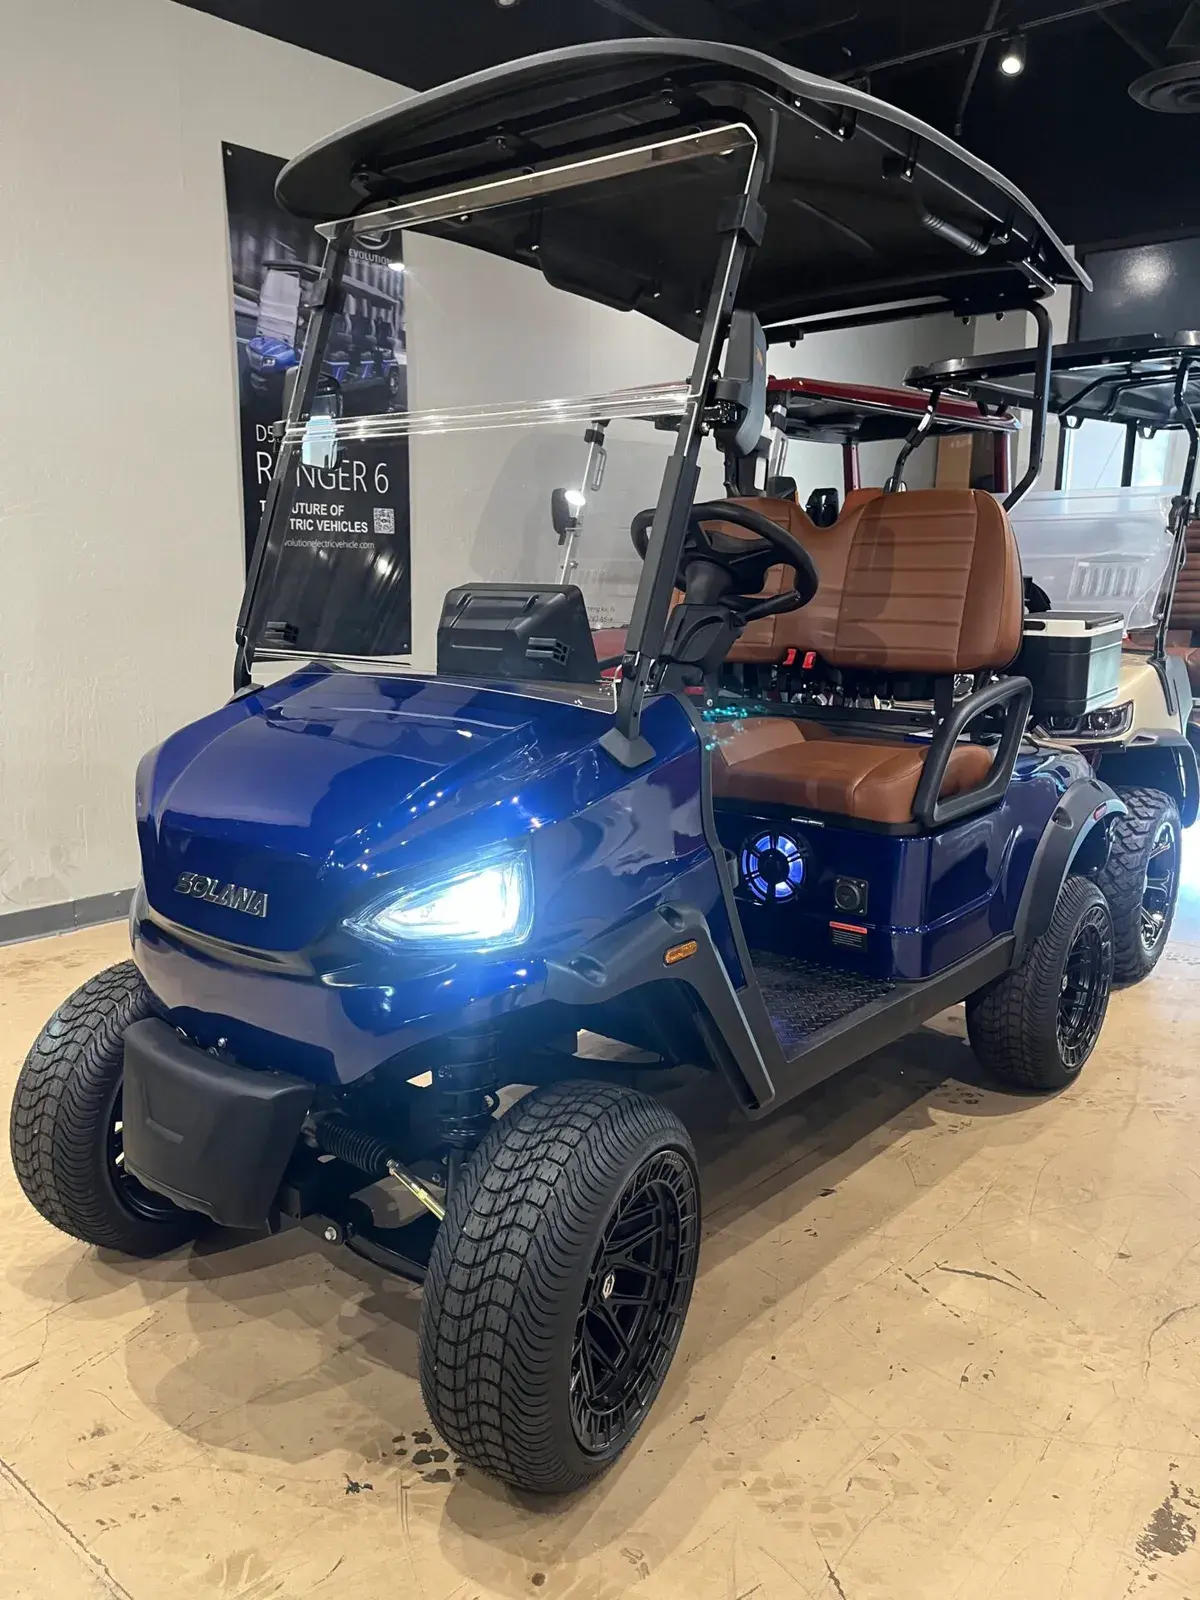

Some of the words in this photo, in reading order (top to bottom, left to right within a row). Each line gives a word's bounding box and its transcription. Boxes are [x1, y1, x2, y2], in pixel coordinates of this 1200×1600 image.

[348, 248, 393, 265] EVOLUTION
[256, 451, 368, 493] RNGER
[374, 462, 389, 494] 6
[292, 502, 328, 516] UTURE
[330, 505, 345, 516] OF
[290, 518, 314, 531] TRIC
[316, 519, 369, 533] VEHICLES
[284, 540, 375, 550] volutionelectricvehicle.com
[173, 871, 269, 918] SOLANA
